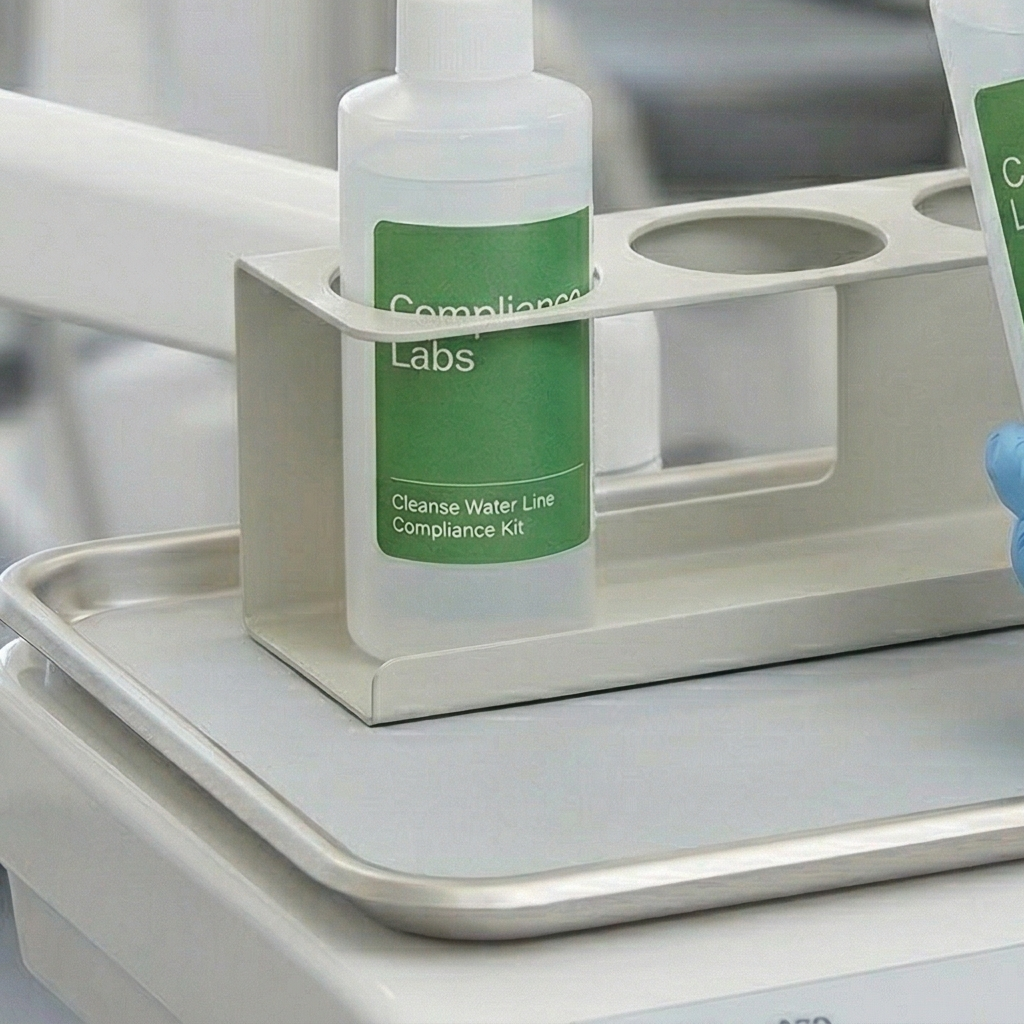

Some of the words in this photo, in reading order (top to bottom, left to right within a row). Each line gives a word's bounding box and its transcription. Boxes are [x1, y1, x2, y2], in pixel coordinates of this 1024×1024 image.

[391, 339, 475, 372] Labs
[392, 493, 460, 515] Cleanse
[465, 498, 518, 515] Water
[522, 493, 555, 511] Line
[392, 516, 496, 541] Compliance
[501, 518, 524, 536] Kit
